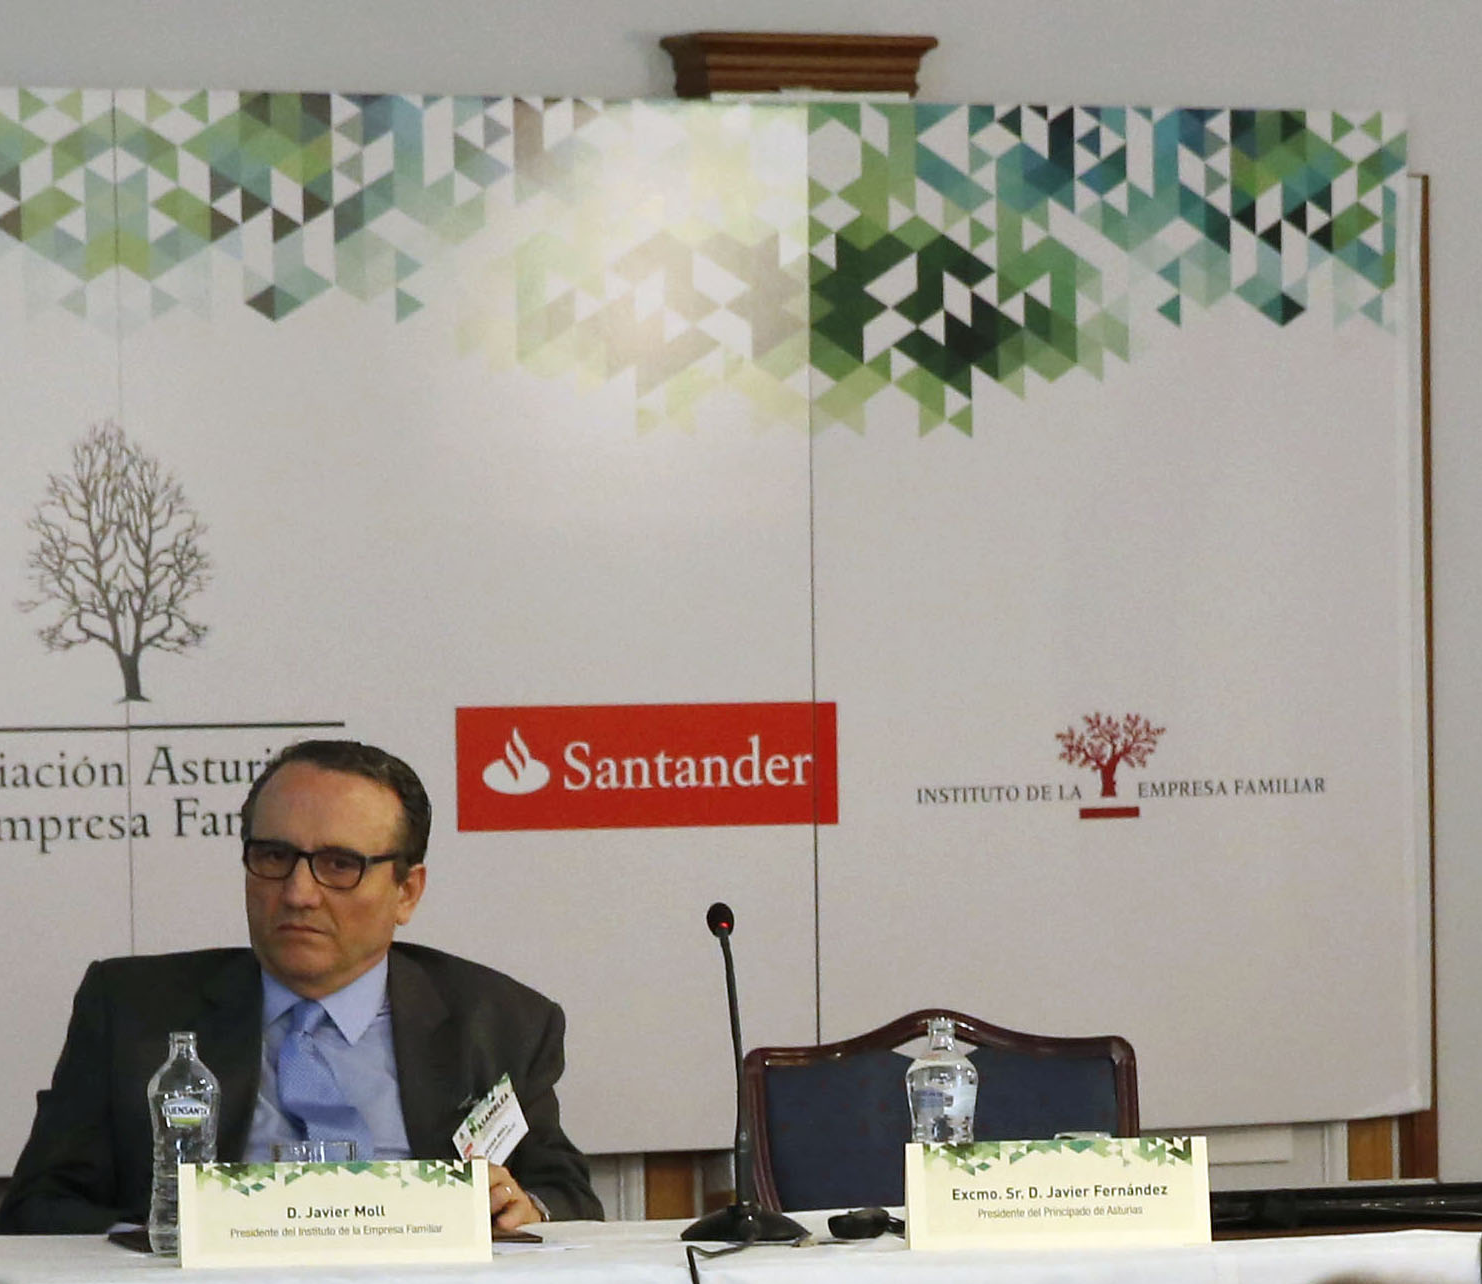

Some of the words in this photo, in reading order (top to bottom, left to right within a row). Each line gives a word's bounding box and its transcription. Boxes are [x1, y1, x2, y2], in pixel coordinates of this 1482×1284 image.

[563, 734, 813, 790] Santander
[917, 786, 1020, 804] INSTITUTO
[1026, 785, 1053, 801] DE
[1059, 784, 1083, 801] LA
[1138, 780, 1227, 799] EMPRESA
[1234, 777, 1326, 796] FAMILIAR
[951, 1187, 1003, 1201] Excmo.
[1006, 1186, 1024, 1200] Sr.
[1028, 1186, 1043, 1199] D.
[1047, 1185, 1090, 1199] Javier
[1094, 1183, 1169, 1198] Fernández
[286, 1206, 301, 1219] D.
[306, 1205, 349, 1219] Javier
[354, 1204, 386, 1218] Moll
[977, 1207, 1025, 1219] Presidente
[1028, 1206, 1041, 1218] del
[1044, 1205, 1091, 1219] Principado
[1093, 1205, 1105, 1217] de
[1107, 1204, 1143, 1216] Asturias
[230, 1227, 279, 1239] Presidente
[282, 1226, 296, 1238] del
[298, 1226, 336, 1237] Instituto
[338, 1225, 350, 1236] de
[352, 1225, 362, 1236] la
[363, 1224, 404, 1237] Empresa
[406, 1223, 443, 1235] Familiar
